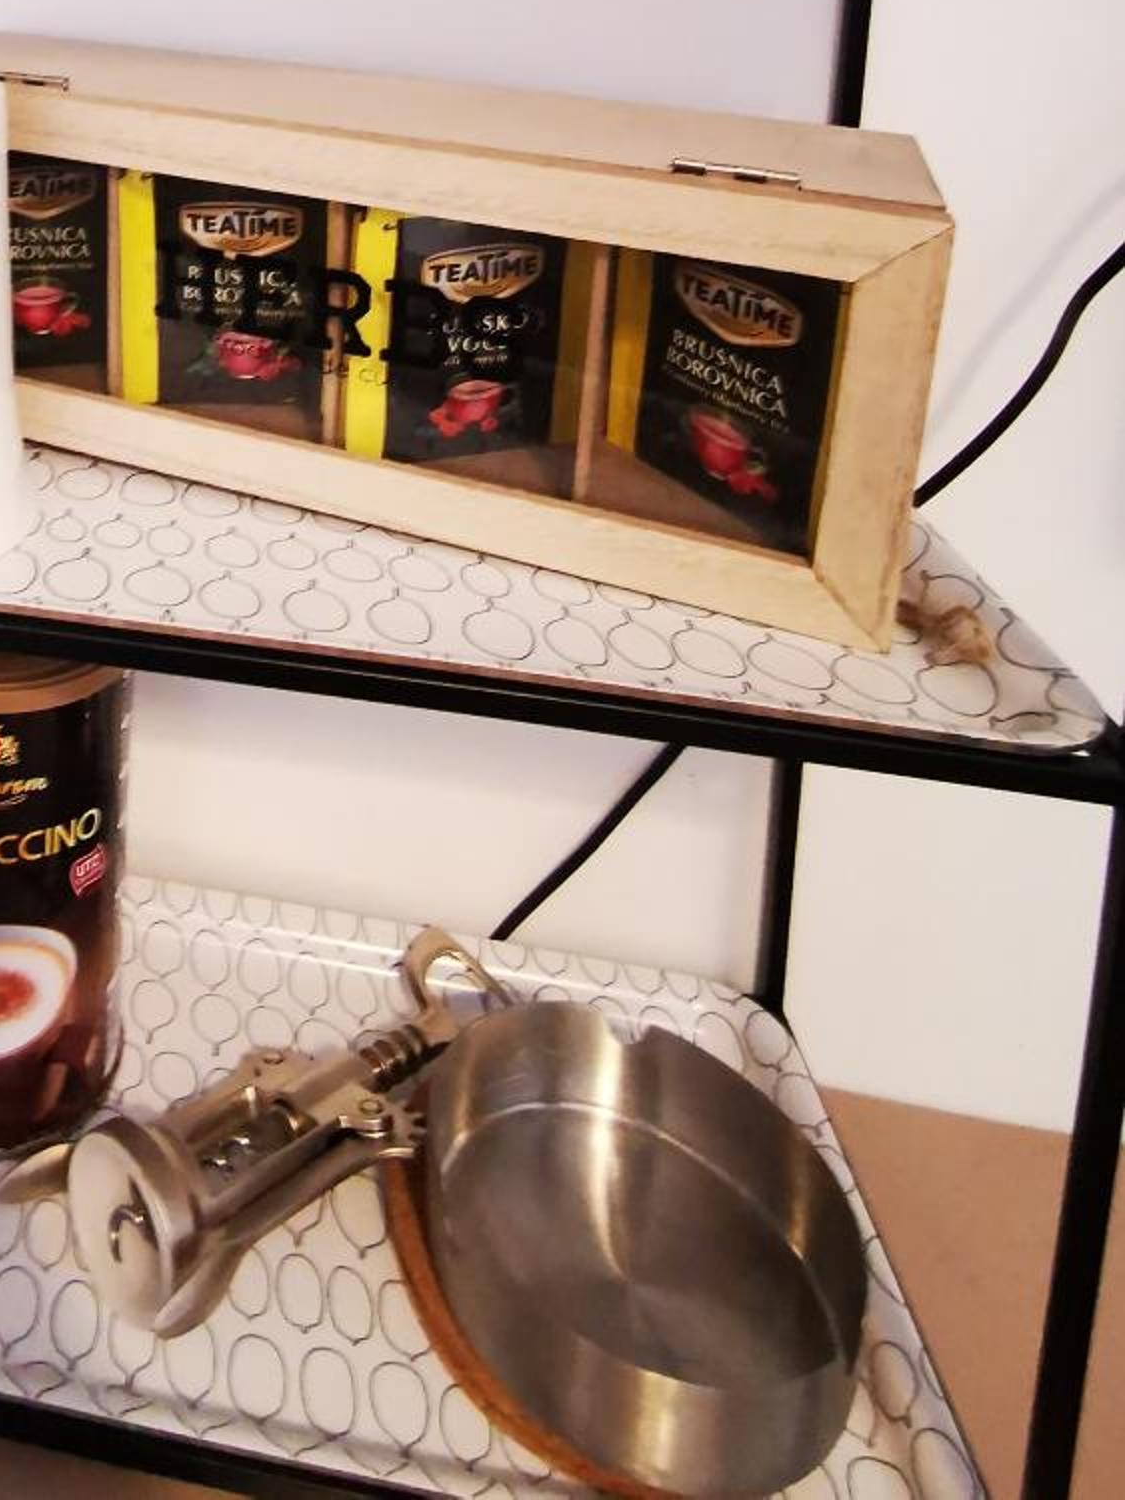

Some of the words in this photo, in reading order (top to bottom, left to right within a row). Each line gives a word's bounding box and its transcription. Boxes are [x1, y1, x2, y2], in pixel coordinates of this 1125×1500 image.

[9, 171, 94, 198] EATIME
[186, 210, 297, 238] TEATIME
[428, 251, 537, 284] TEATIME
[679, 273, 793, 338] TEATIME
[666, 346, 787, 418] BOROVNICA
[672, 328, 783, 395] BRUSNICA
